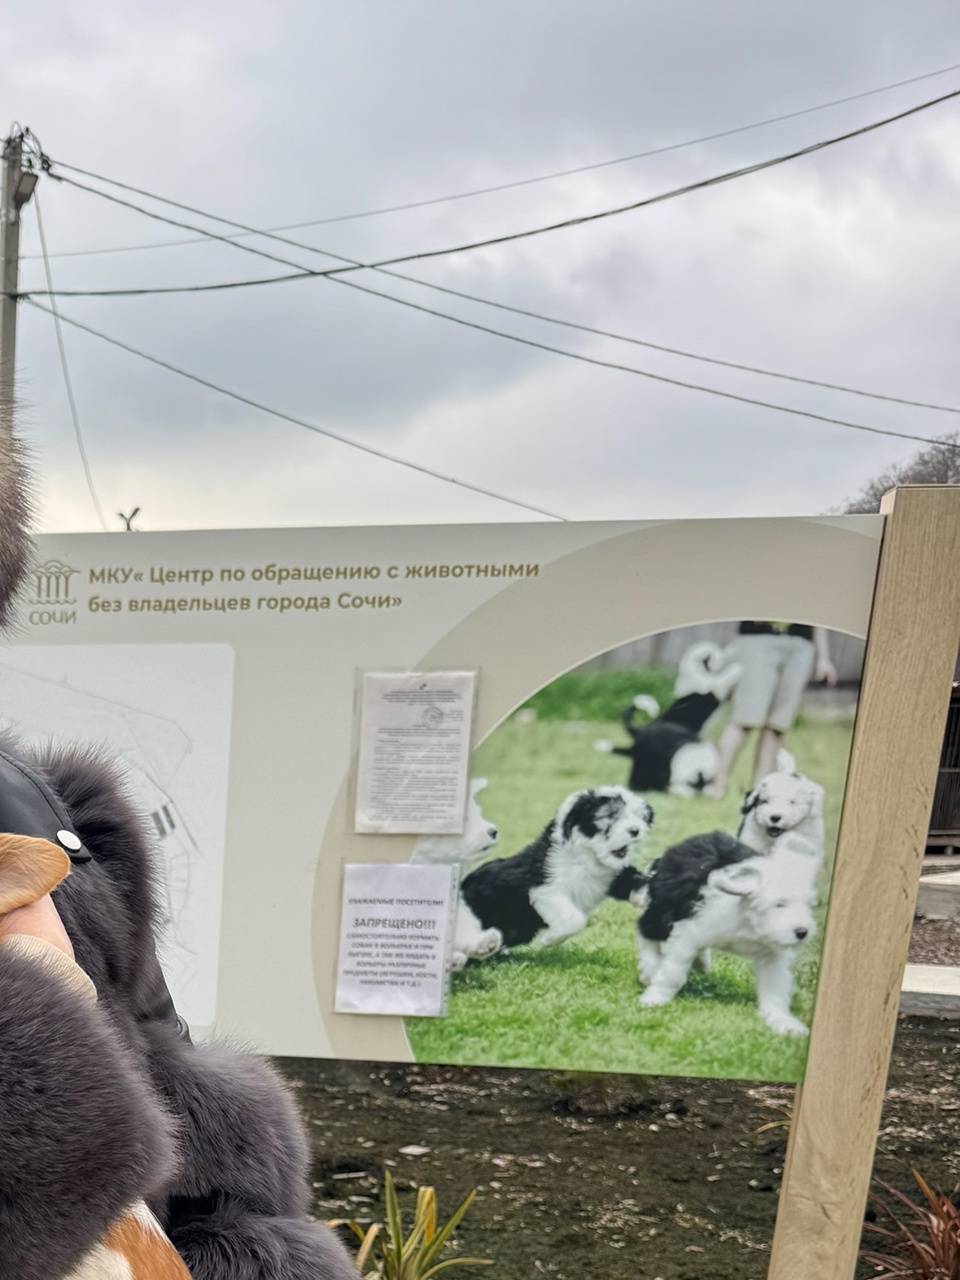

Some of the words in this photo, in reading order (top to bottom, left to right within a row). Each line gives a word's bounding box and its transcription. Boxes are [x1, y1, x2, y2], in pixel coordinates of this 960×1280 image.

[89, 567, 143, 584] МКУ«
[149, 566, 214, 586] Центр
[220, 567, 245, 582] по
[251, 564, 380, 584] обращению
[387, 565, 399, 579] с
[405, 563, 539, 578] животными
[88, 596, 122, 613] без
[128, 597, 251, 614] владельцев
[257, 595, 331, 613] города
[337, 592, 402, 610] Сочи»
[352, 918, 435, 929] ЗАПРЕЩЕНО!!!
